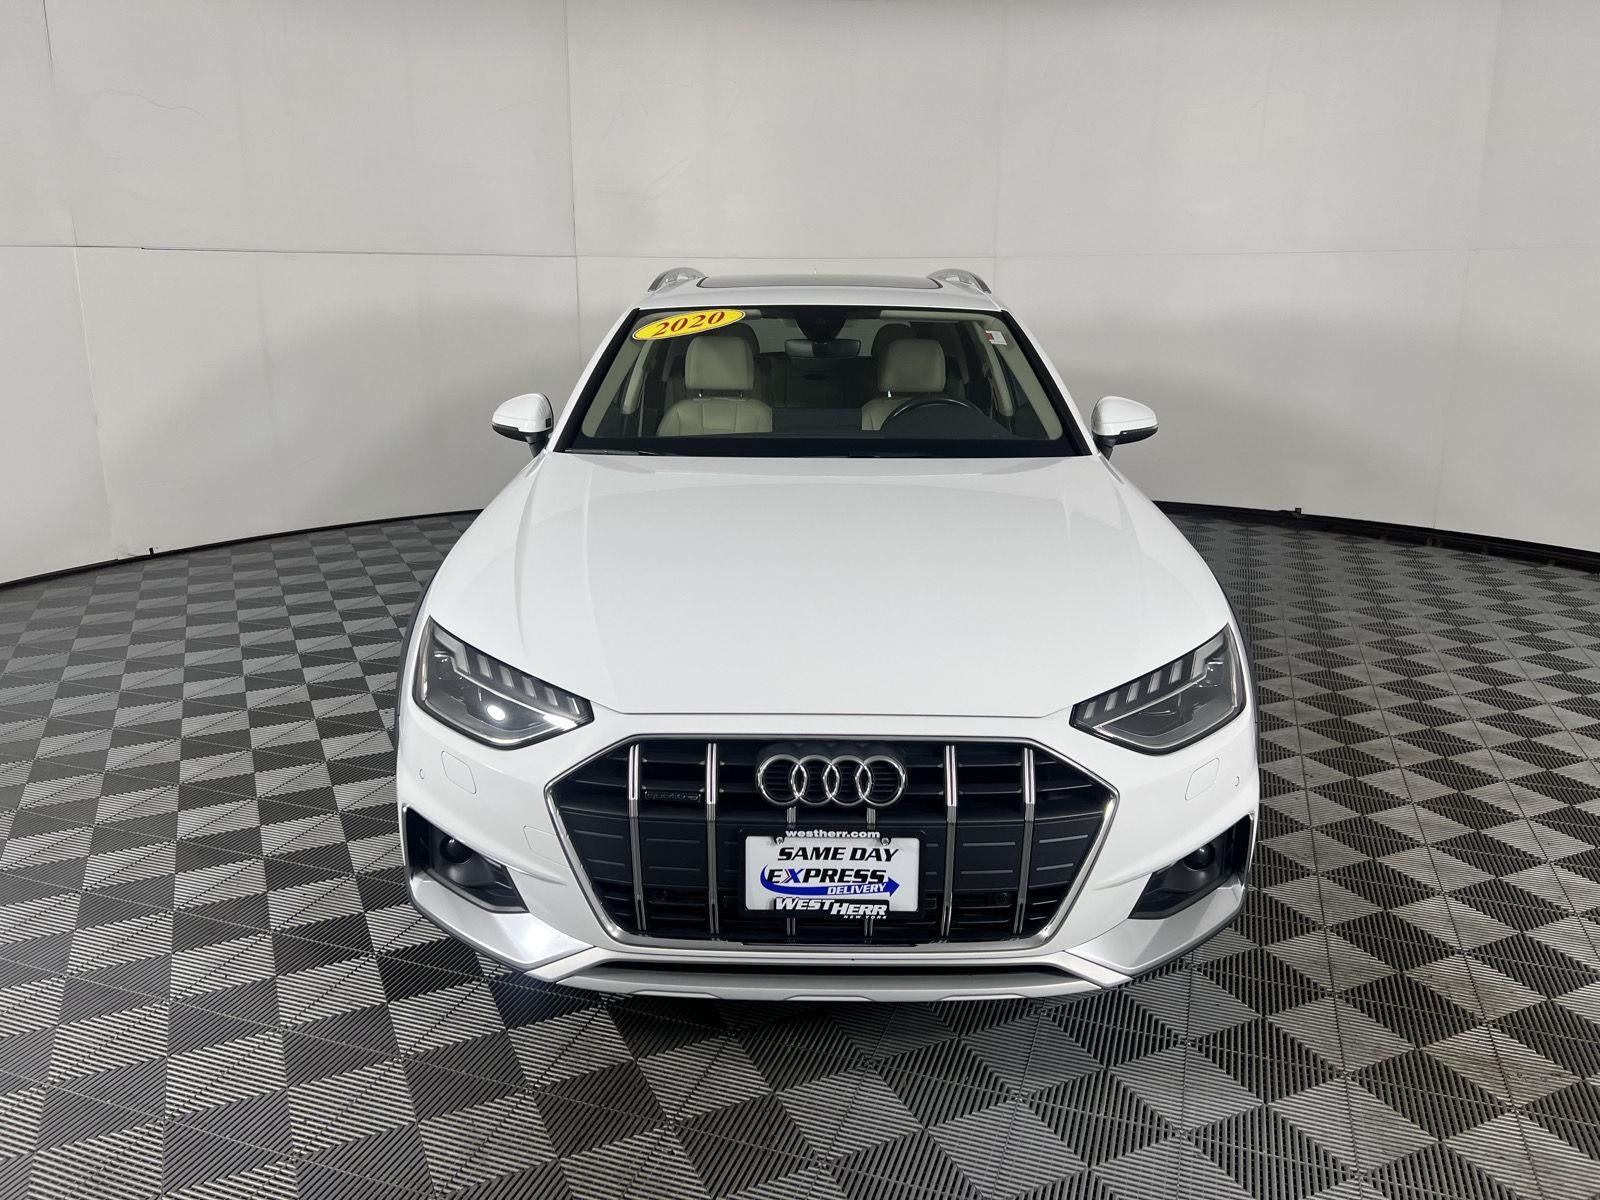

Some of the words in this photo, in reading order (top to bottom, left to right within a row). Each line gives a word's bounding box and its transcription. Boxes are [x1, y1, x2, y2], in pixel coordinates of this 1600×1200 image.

[651, 311, 725, 337] 2020
[785, 829, 881, 838] westherr.com
[778, 847, 846, 861] SAME
[850, 847, 899, 862] DAY
[767, 868, 887, 884] EXPRESS
[827, 884, 886, 895] DELIVERY
